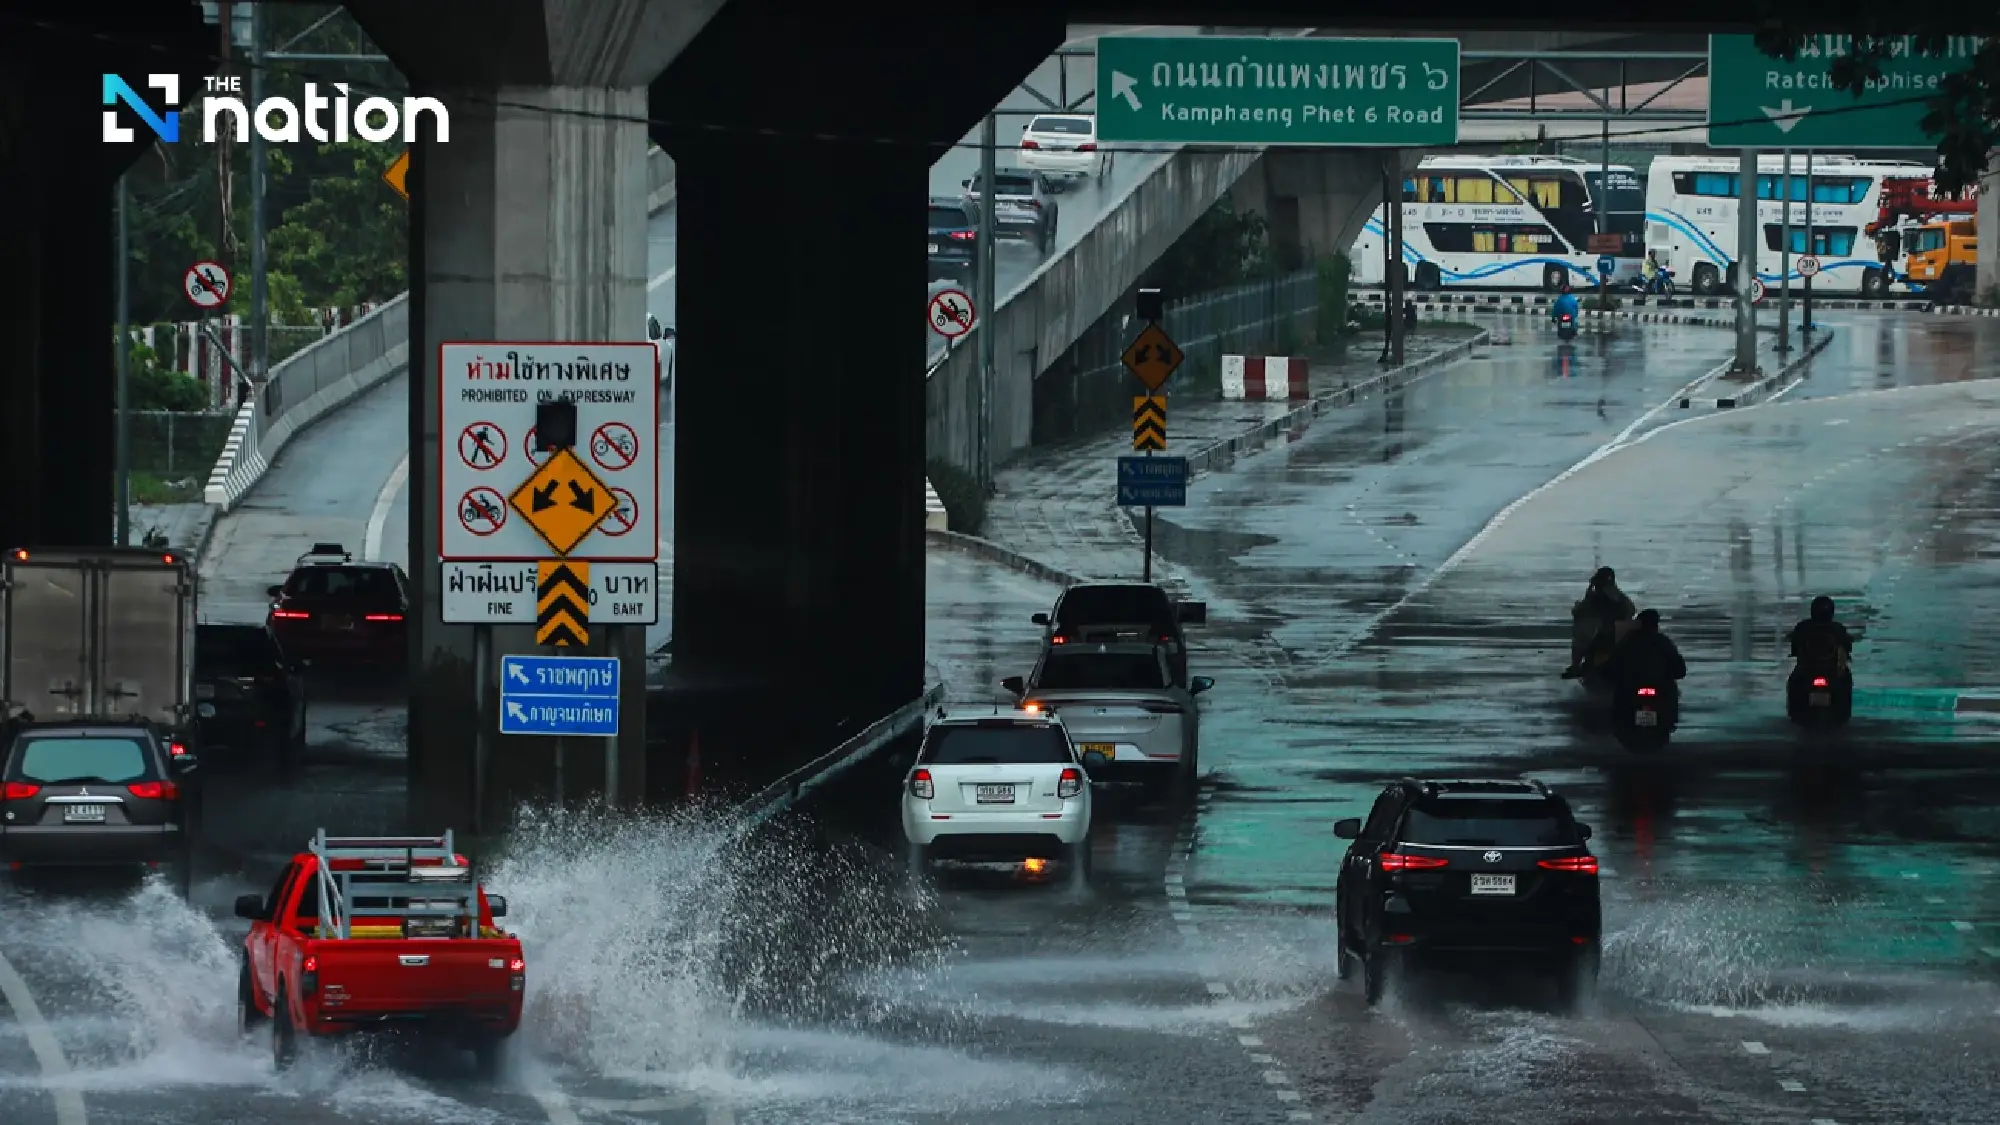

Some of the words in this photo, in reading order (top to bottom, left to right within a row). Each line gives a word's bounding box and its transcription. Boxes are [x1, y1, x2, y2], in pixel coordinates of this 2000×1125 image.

[1151, 54, 1407, 90] ถนนกำแพงเพชร
[1161, 102, 1293, 128] Kamphaeng
[1302, 104, 1356, 124] Phet
[1365, 104, 1378, 124] 6
[1387, 105, 1443, 125] Road
[466, 350, 631, 381] ห้ามใช้ทางพิเศษ
[461, 388, 529, 404] PROHIBITED
[536, 388, 553, 402] ON
[562, 388, 636, 404] EXPRESSWAY
[604, 575, 649, 594] บาท
[487, 601, 513, 615] FINE
[613, 601, 644, 615] BAHT
[536, 662, 613, 692] ราชพฤกษ์
[530, 701, 613, 727] กาญจนาภิเษก
